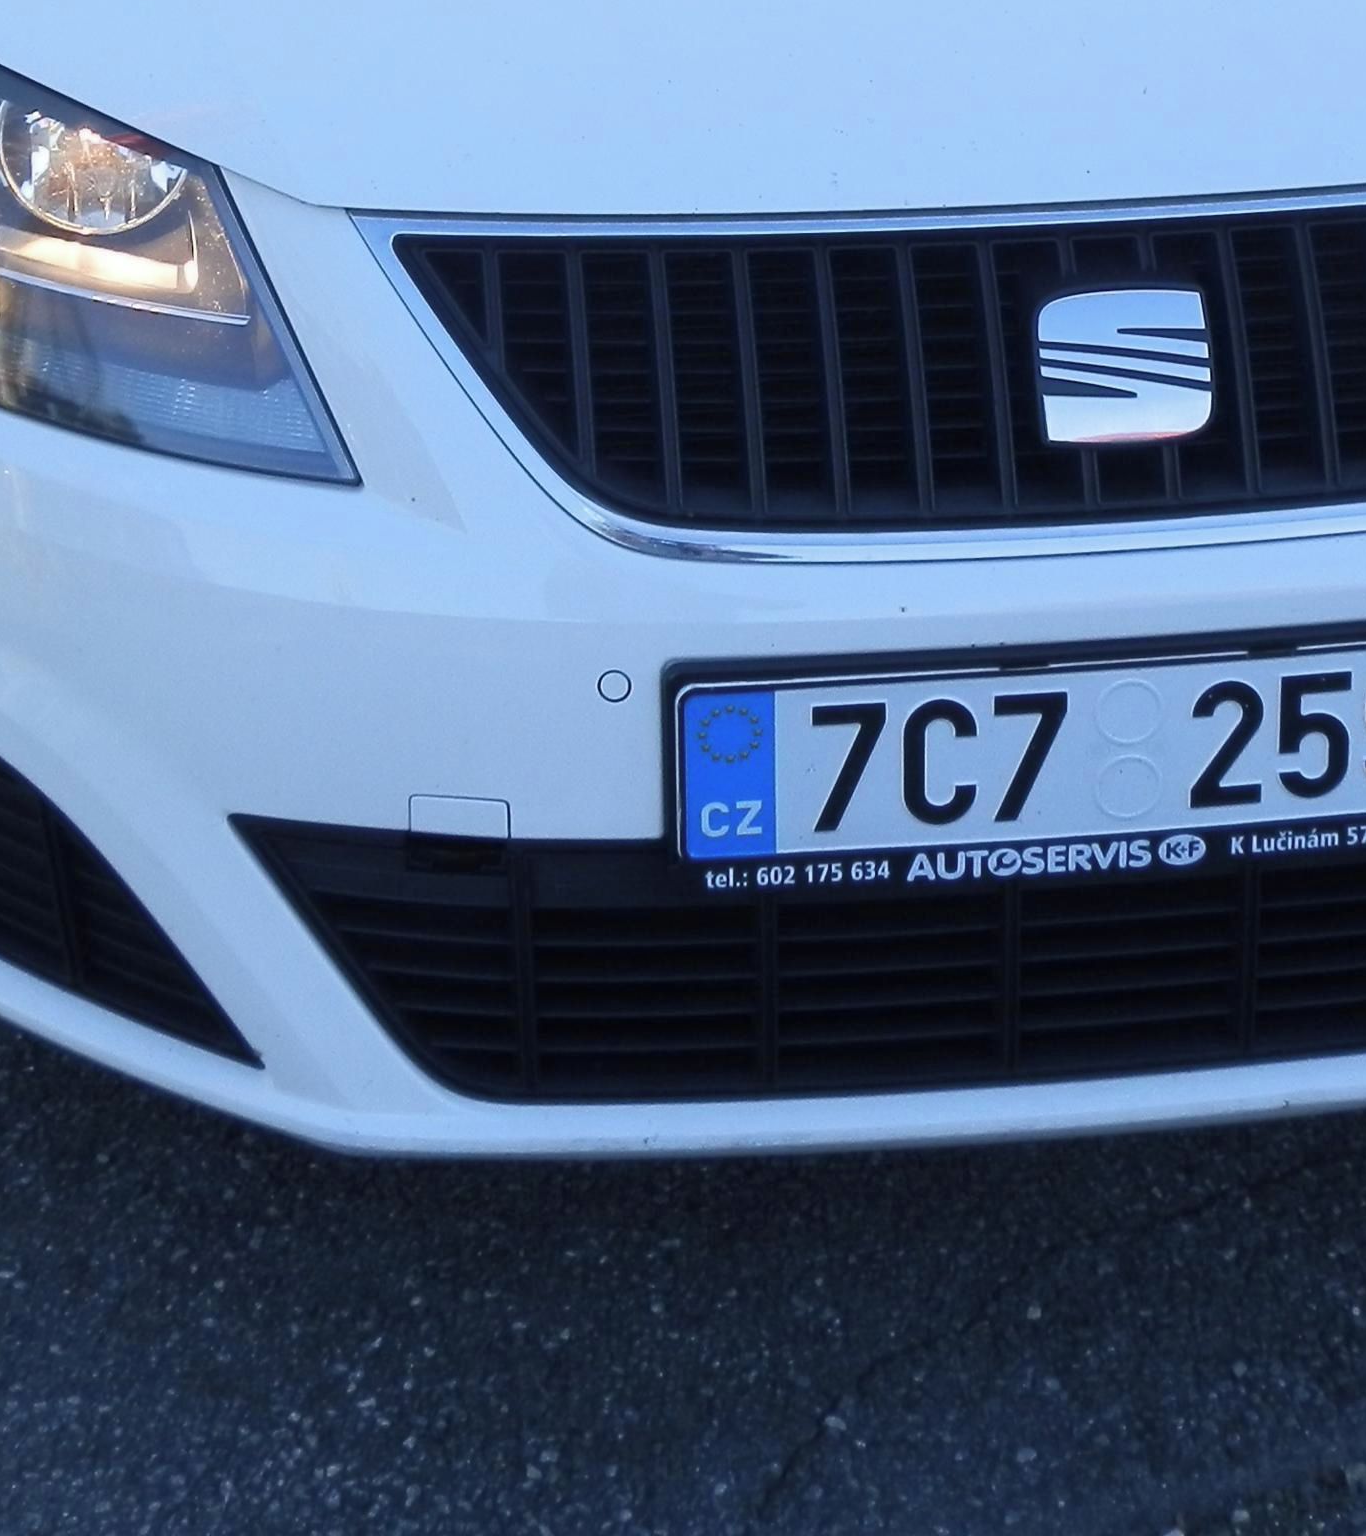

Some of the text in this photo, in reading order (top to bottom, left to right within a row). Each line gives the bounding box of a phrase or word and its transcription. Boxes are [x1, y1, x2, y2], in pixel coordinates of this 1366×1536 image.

[811, 691, 1069, 833] 7C7
[700, 800, 763, 838] CZ
[906, 839, 1152, 882] AUTOSERVIS
[1230, 835, 1245, 856] K
[1251, 829, 1339, 854] Lučinám
[705, 860, 891, 889] tel.: 602 175 634
